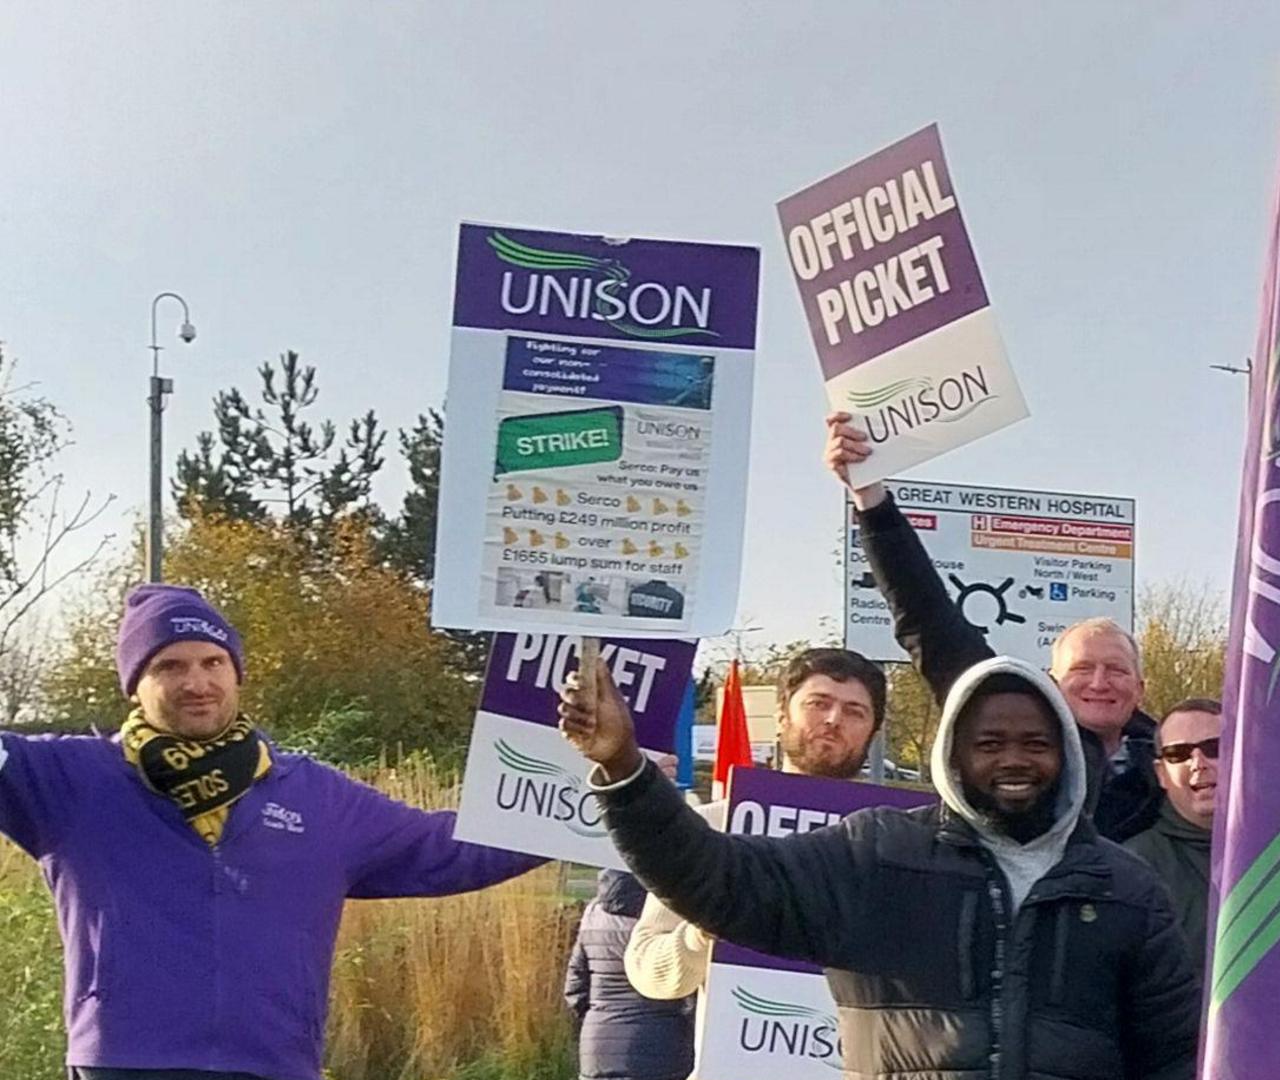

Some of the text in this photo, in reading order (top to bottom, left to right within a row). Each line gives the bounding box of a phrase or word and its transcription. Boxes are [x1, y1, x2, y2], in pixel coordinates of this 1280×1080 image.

[789, 161, 955, 280] OFFICIAL
[502, 270, 711, 329] UNISON
[817, 235, 951, 346] PICKET
[865, 365, 989, 443] UNISON
[517, 428, 610, 455] STRIKE!
[637, 422, 700, 440] UNISON
[660, 464, 684, 477] Pay
[630, 478, 653, 488] you
[577, 492, 621, 508] Serco
[897, 487, 1124, 518] GREAT WESTERN HOSPITAL
[502, 506, 690, 534] Putting £249 million profit
[992, 518, 1060, 536] Emergency
[1061, 523, 1131, 541] Department
[578, 536, 612, 548] over
[974, 536, 1117, 555] Urgent Treatment Centre
[502, 548, 684, 575] £1655 lump sum for staff
[932, 559, 965, 570] ouse
[1034, 557, 1112, 574] Visitor Parking
[1034, 568, 1064, 580] North
[1072, 570, 1098, 582] West
[1072, 587, 1116, 601] Parking
[850, 612, 891, 626] Centre
[506, 633, 667, 713] PICET
[497, 774, 601, 827] UNISO
[741, 1017, 843, 1059] UNIS
